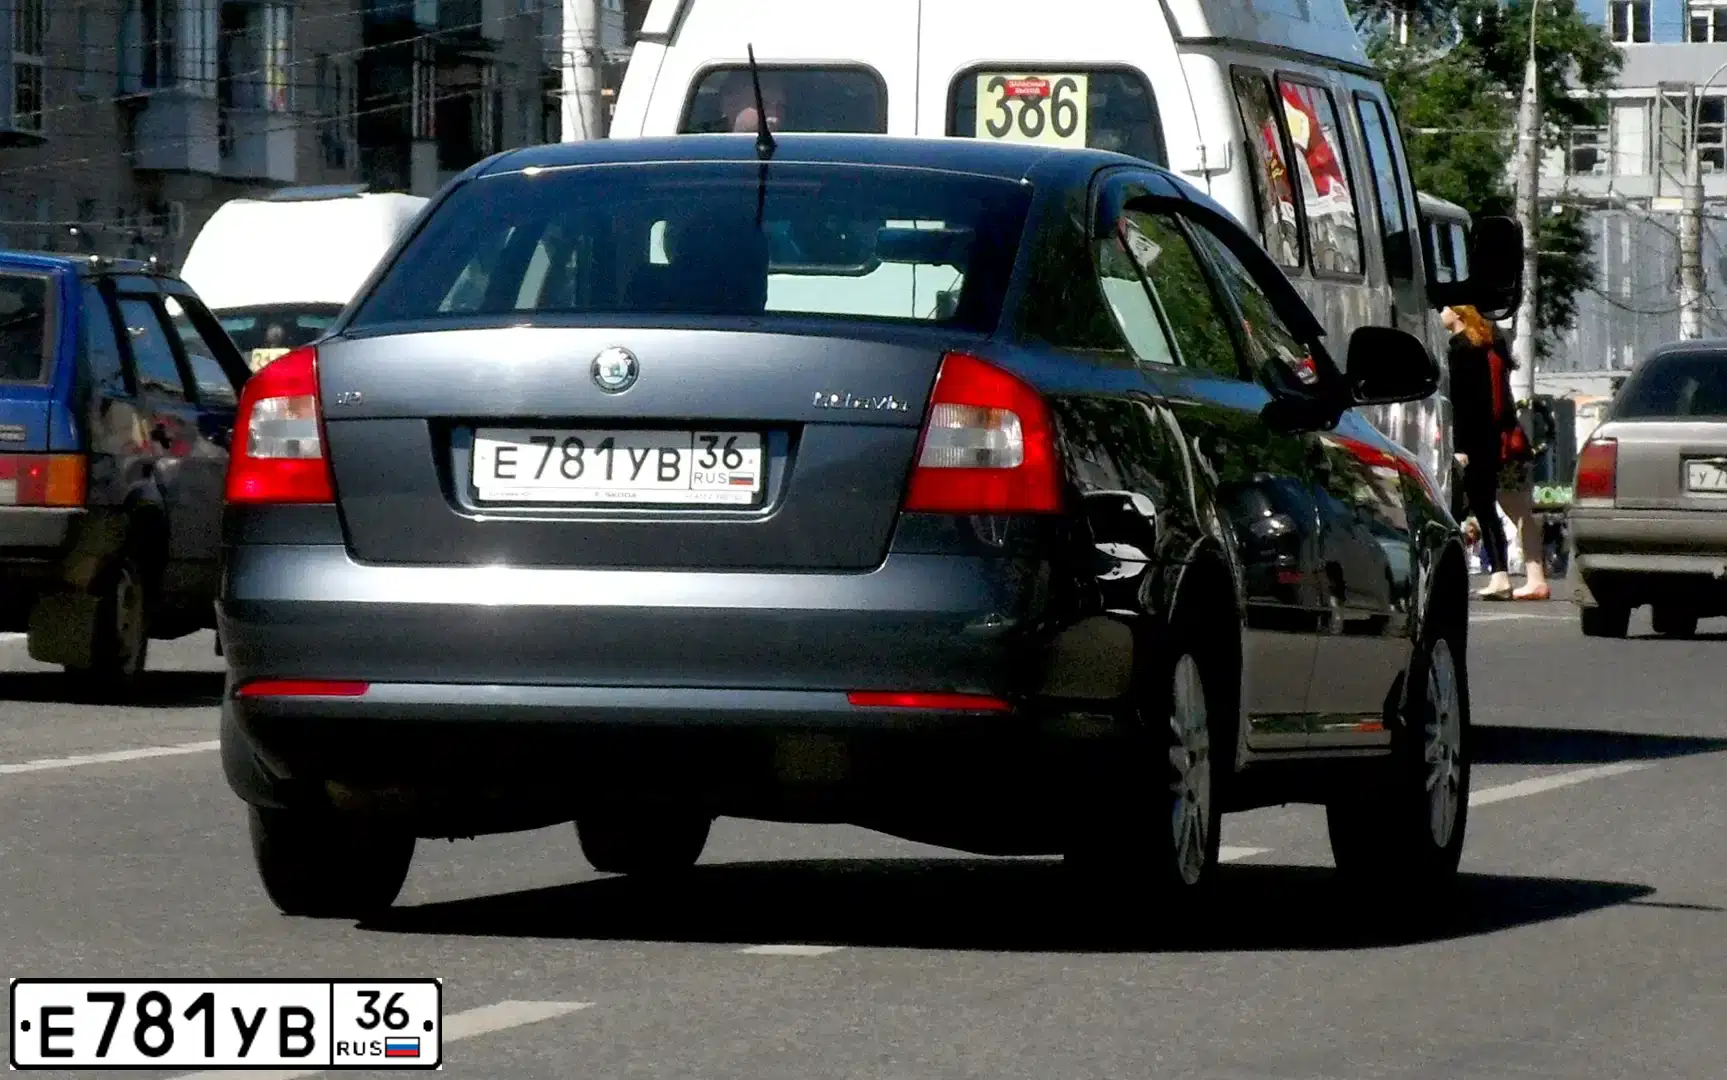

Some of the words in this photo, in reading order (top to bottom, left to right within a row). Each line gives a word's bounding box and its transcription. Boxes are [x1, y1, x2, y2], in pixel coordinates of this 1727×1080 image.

[985, 76, 1079, 138] 386
[698, 435, 743, 470] 36
[693, 472, 727, 484] RUS
